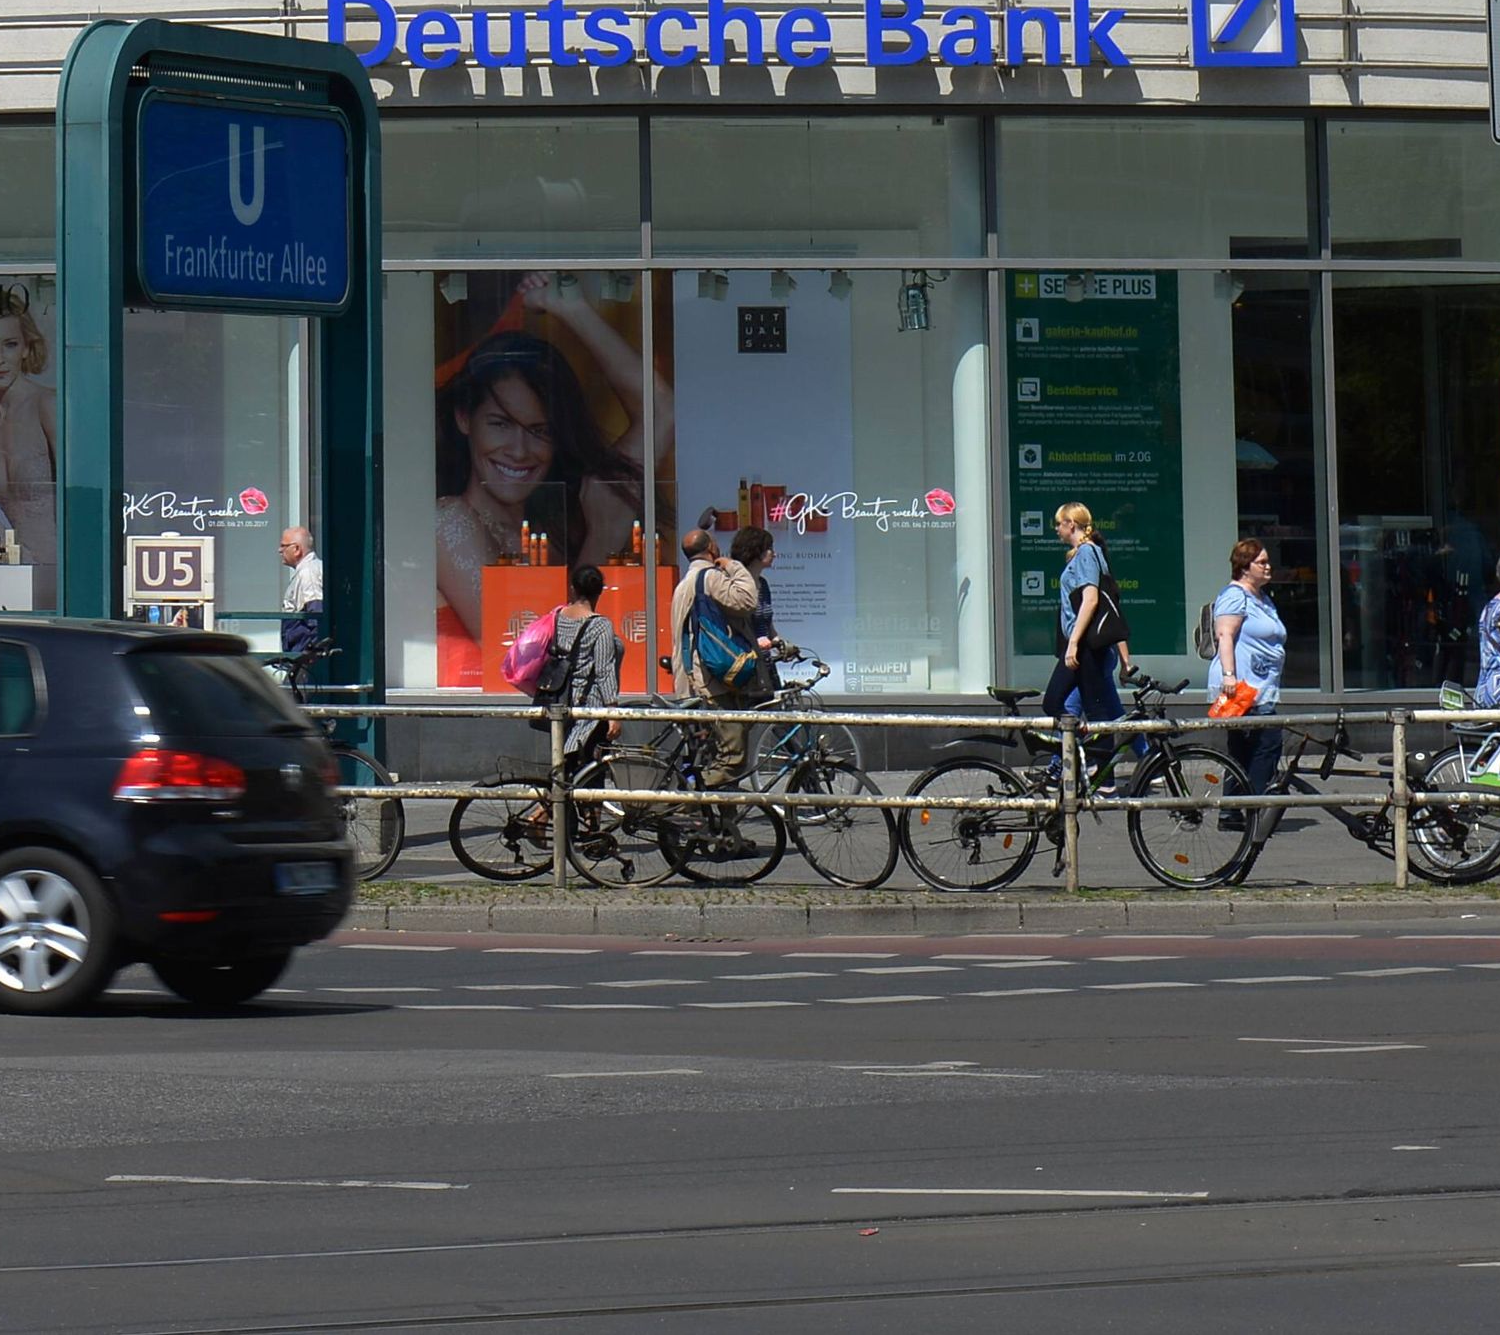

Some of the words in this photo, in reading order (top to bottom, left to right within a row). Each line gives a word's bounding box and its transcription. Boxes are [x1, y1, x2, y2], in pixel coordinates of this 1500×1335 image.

[228, 123, 265, 226] U
[165, 234, 274, 283] Frankfurter
[280, 241, 328, 286] Allee
[1112, 278, 1152, 296] PLUS
[1114, 450, 1126, 462] im
[150, 491, 214, 531] Beauty
[208, 498, 244, 518] weeks
[826, 491, 898, 532] Beauty
[890, 498, 930, 519] weeks
